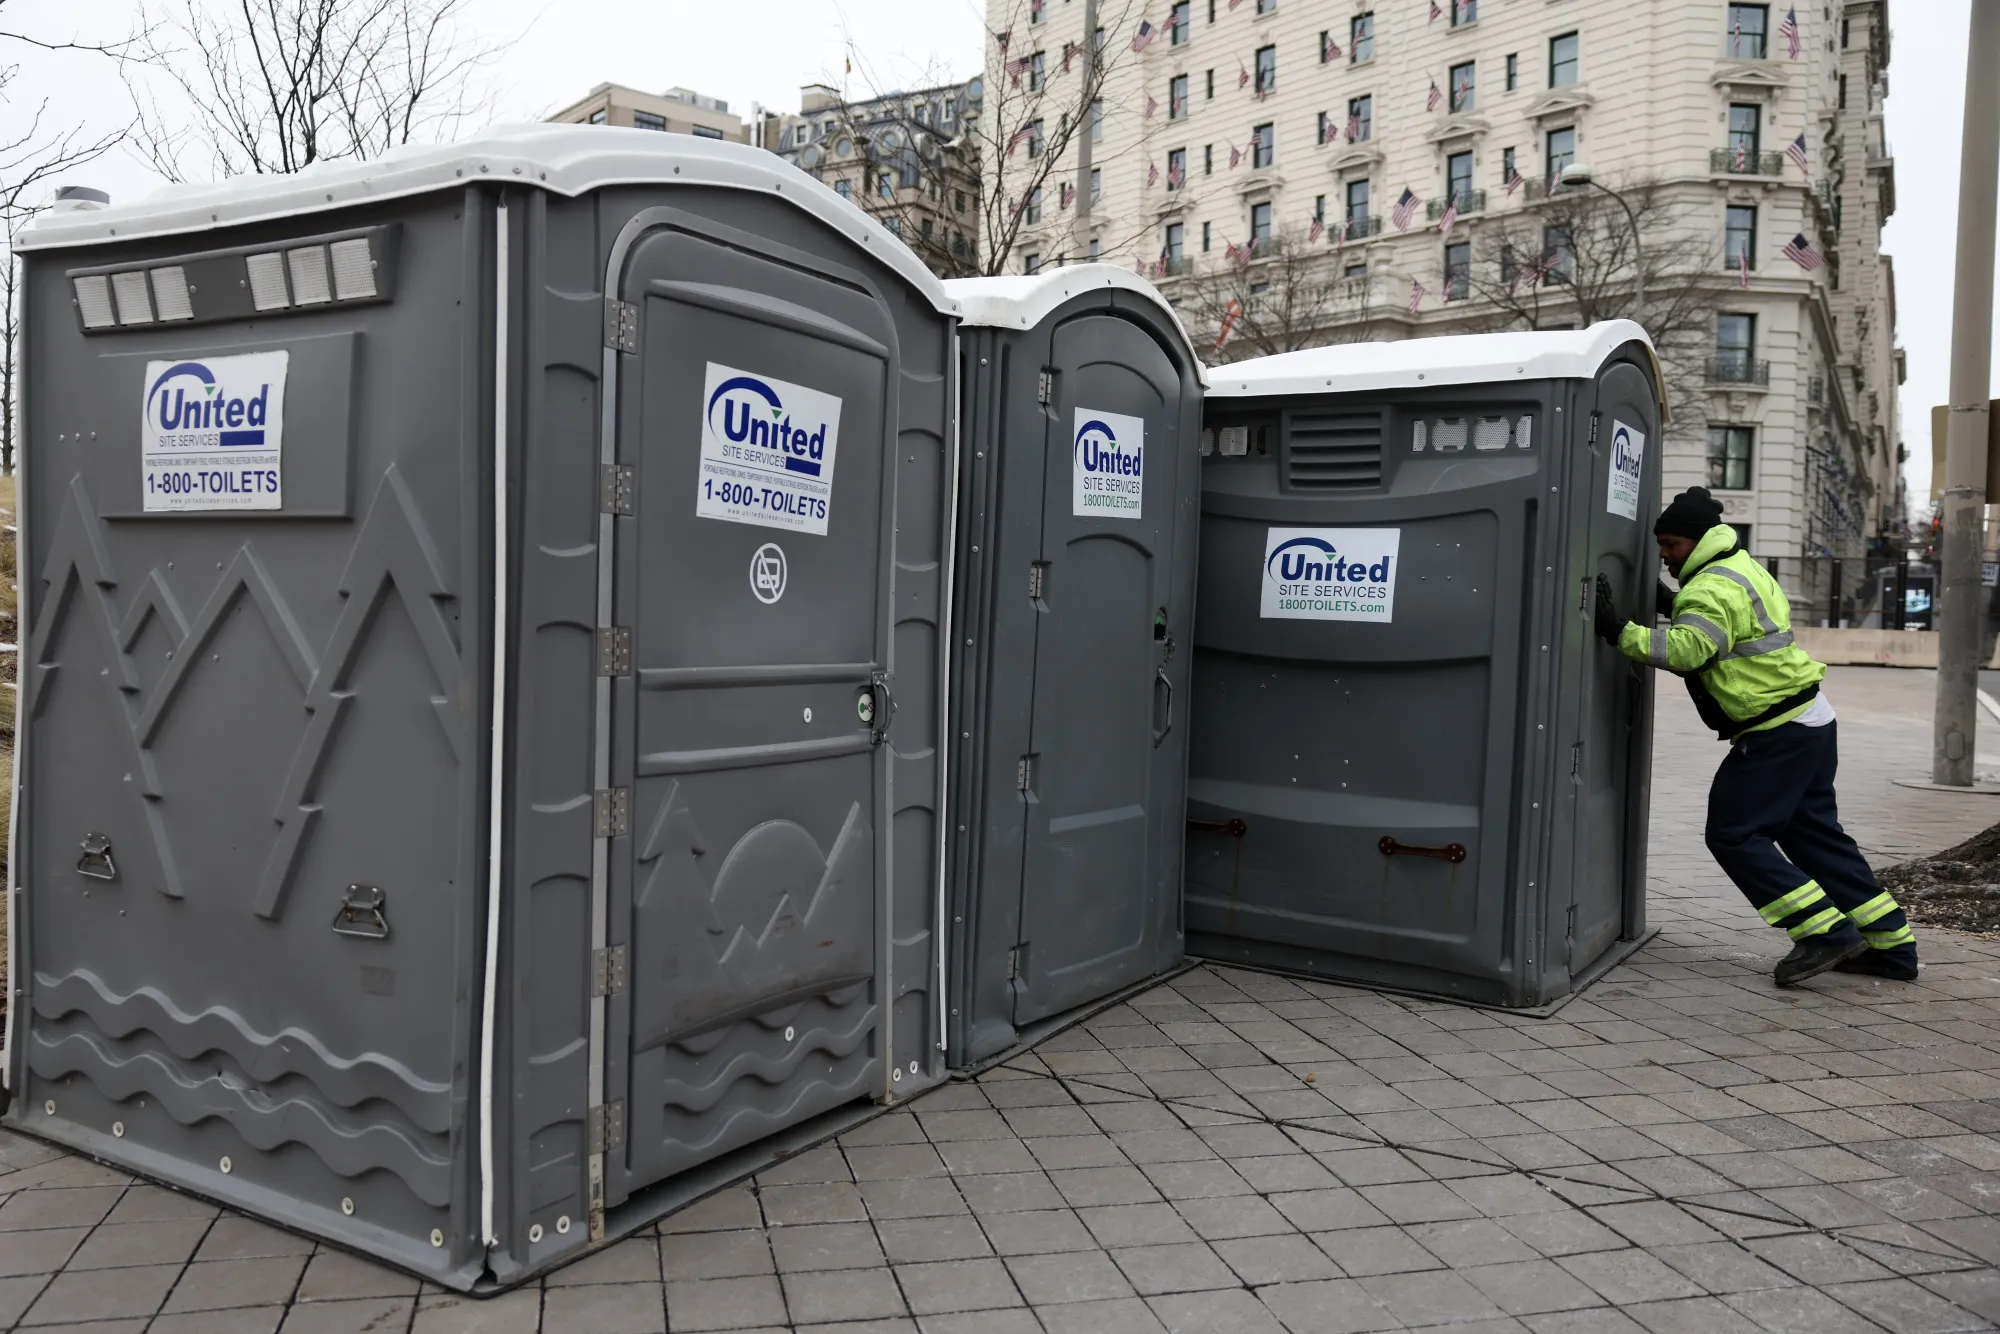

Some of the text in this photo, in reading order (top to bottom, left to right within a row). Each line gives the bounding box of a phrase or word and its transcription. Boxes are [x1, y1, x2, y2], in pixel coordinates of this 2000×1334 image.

[160, 383, 269, 430] United
[159, 433, 219, 447] SITE SERVICES
[724, 398, 827, 461] United
[722, 444, 785, 468] SITE SERVICES
[1084, 439, 1141, 477] United
[1615, 443, 1641, 479] United
[147, 471, 278, 494] 1-800-TOILETS
[1084, 477, 1140, 494] SITE SERVICES
[704, 479, 826, 519] 1-800-TOILETS
[1084, 494, 1140, 509] 1800TOILETS.com
[1281, 553, 1390, 583] United
[1279, 584, 1387, 598] SITE SERVICES
[1278, 599, 1385, 613] 1800TOILETS.com
